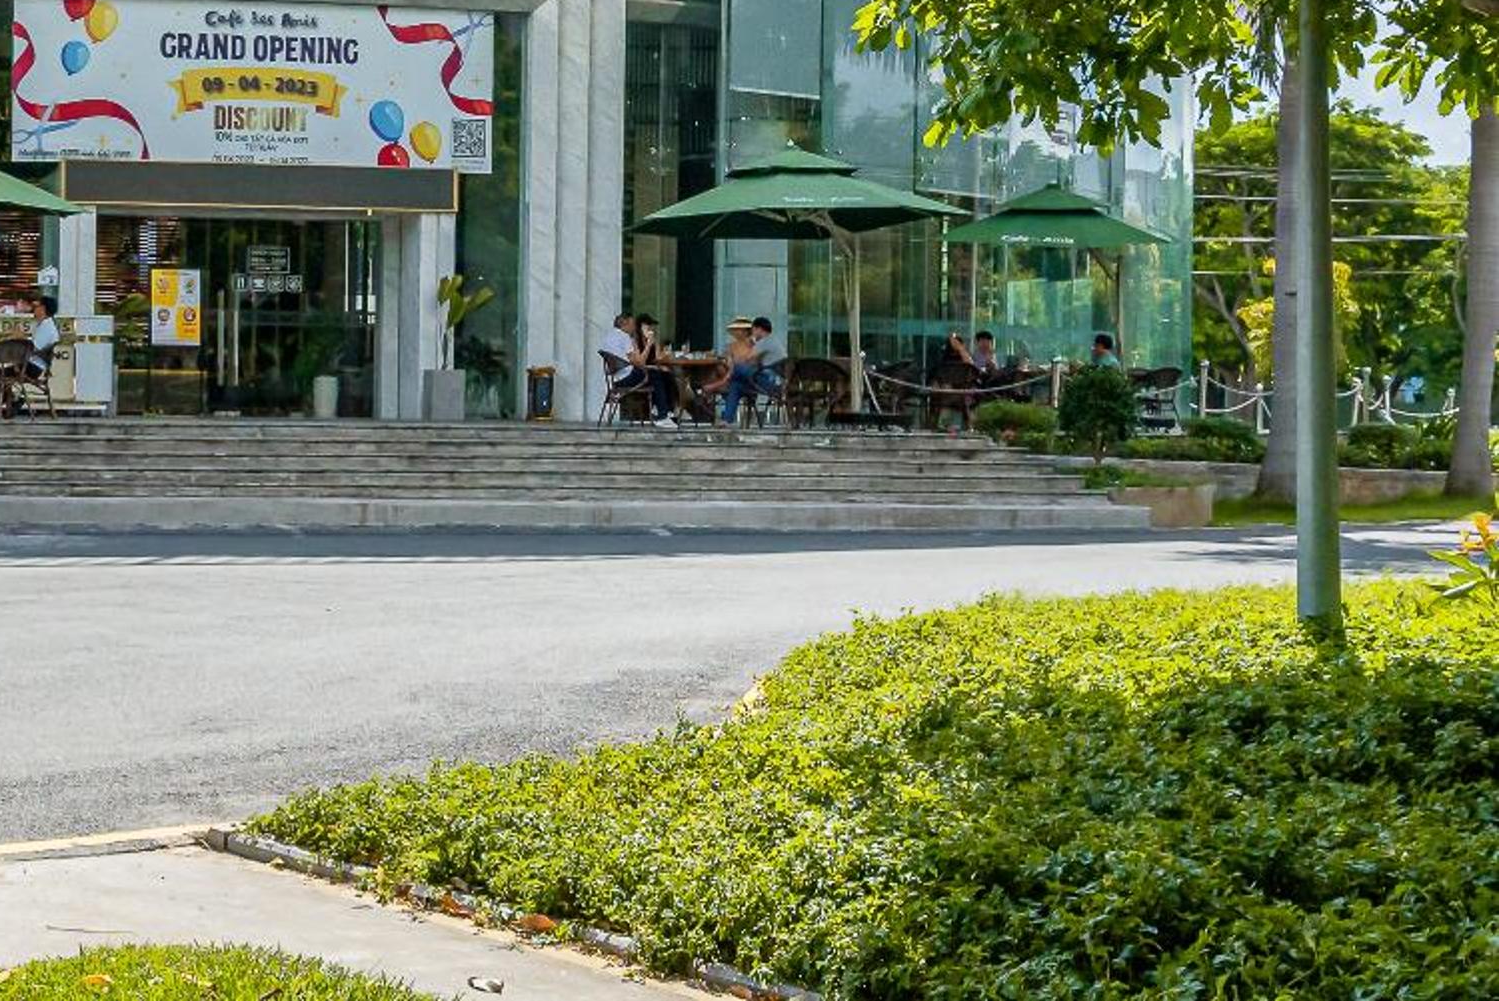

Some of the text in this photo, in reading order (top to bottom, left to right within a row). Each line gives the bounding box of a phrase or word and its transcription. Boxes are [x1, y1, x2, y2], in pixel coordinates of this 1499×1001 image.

[159, 32, 360, 65] GRAND OPENING
[238, 75, 261, 92] 04
[275, 76, 319, 98] 2023
[214, 105, 308, 132] DISCOUNT
